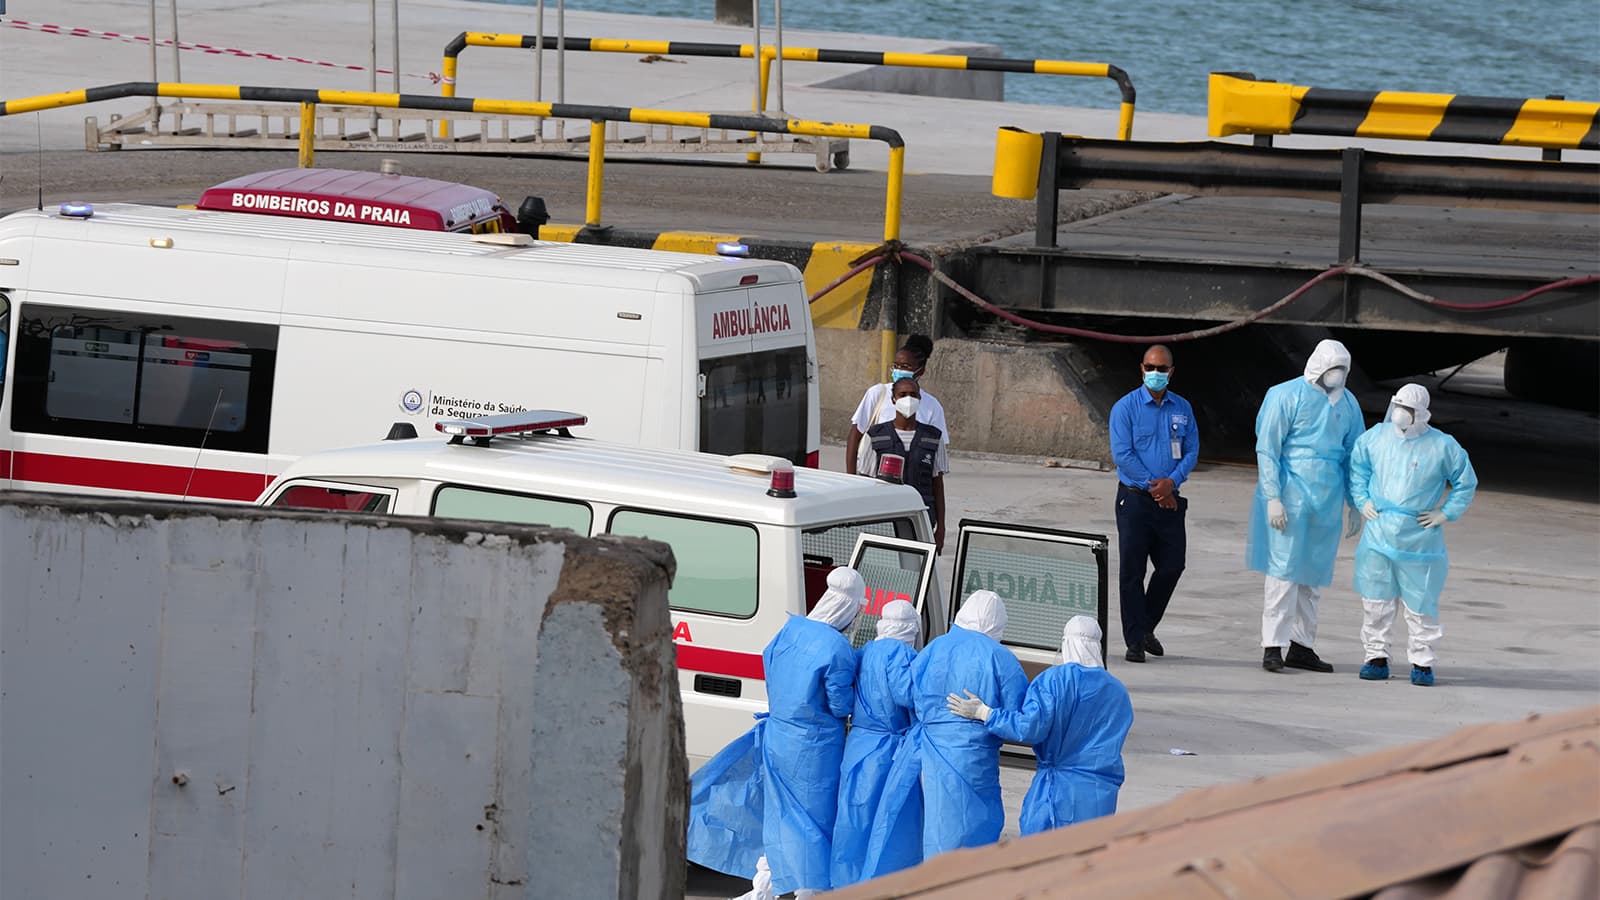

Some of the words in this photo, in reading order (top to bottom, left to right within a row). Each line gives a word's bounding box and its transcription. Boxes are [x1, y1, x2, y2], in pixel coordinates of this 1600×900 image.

[232, 192, 330, 215] BOMBEIROS
[333, 202, 356, 218] DA
[360, 205, 411, 225] PRAIA
[713, 300, 791, 340] AMBULÂNCIA
[431, 406, 444, 416] da
[433, 395, 481, 410] Ministério
[484, 402, 495, 411] da
